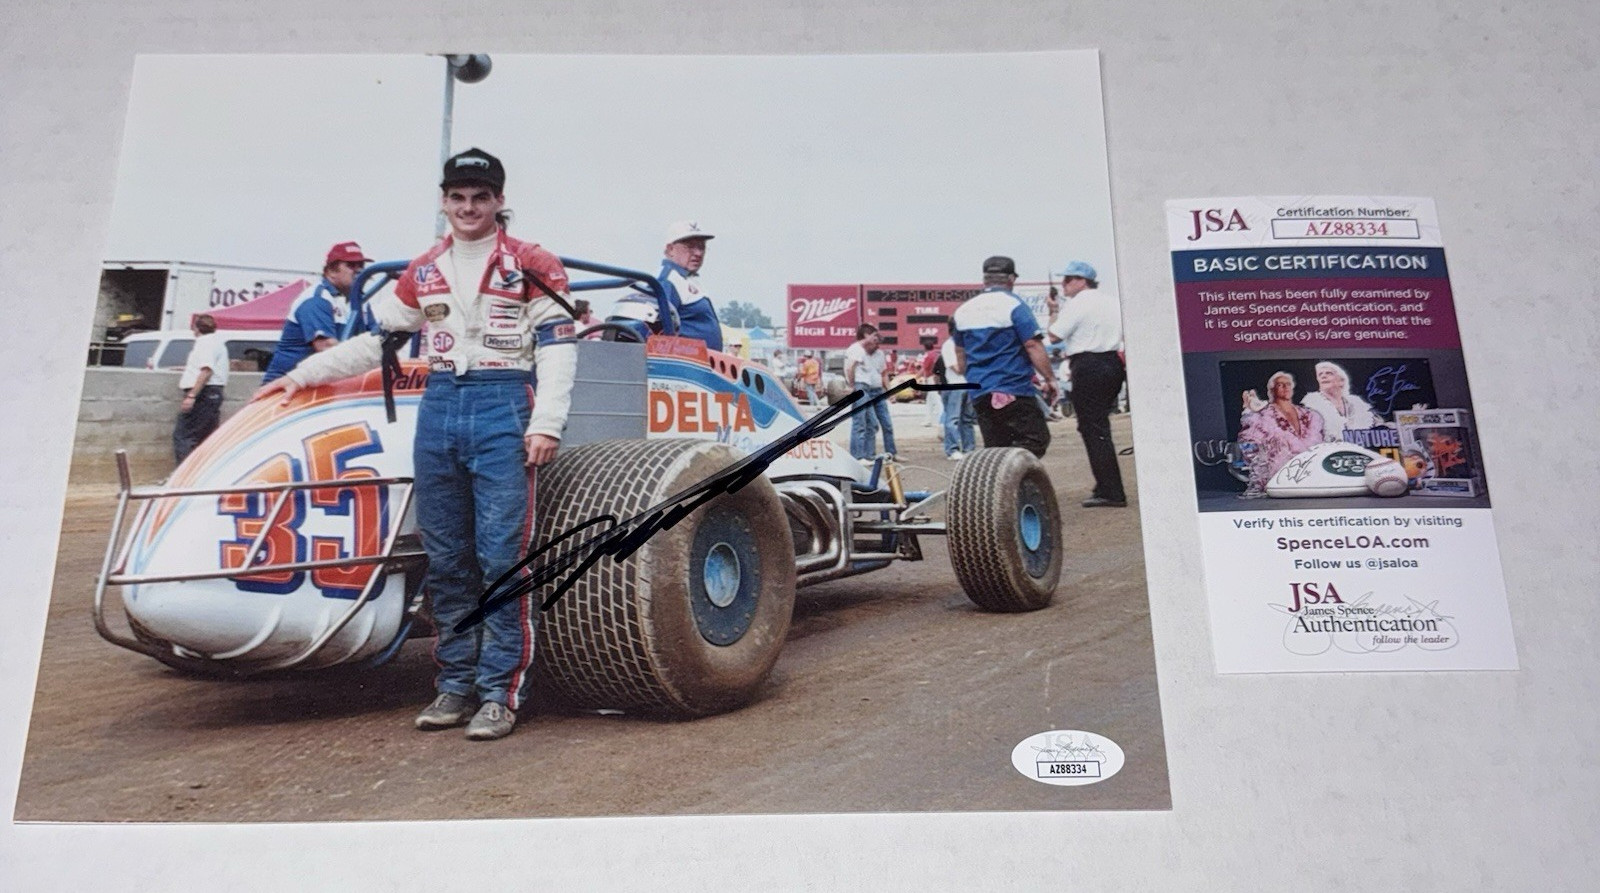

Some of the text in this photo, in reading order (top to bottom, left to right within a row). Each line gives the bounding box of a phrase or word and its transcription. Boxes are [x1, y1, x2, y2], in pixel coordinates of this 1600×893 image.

[1277, 206, 1410, 217] Certification Number:
[1187, 208, 1251, 241] JSA
[1305, 222, 1388, 236] AZ88334
[1194, 254, 1428, 272] BASIC CERTIFICATION
[1198, 288, 1430, 302] This item has been fully examined by
[789, 297, 857, 324] Miller
[1204, 302, 1423, 316] James Spence Authentication, and
[1204, 315, 1432, 329] it is our considered opinion that the
[794, 326, 857, 337] HIGH LIFE
[918, 327, 939, 336] LAP
[1233, 328, 1408, 343] signature(s) is/are genuine.
[649, 391, 756, 433] DELTA
[1342, 429, 1400, 447] NATURE
[218, 420, 389, 600] 35
[1233, 515, 1463, 530] Verify this certification by visiting
[1276, 535, 1430, 552] SpenceLOA.com
[1294, 557, 1419, 571] Follow us @jsaloa
[1288, 582, 1345, 613] JSA
[1304, 604, 1375, 616] James Spence
[1372, 634, 1450, 646] follow the leader
[1049, 764, 1088, 775] AZ88334
